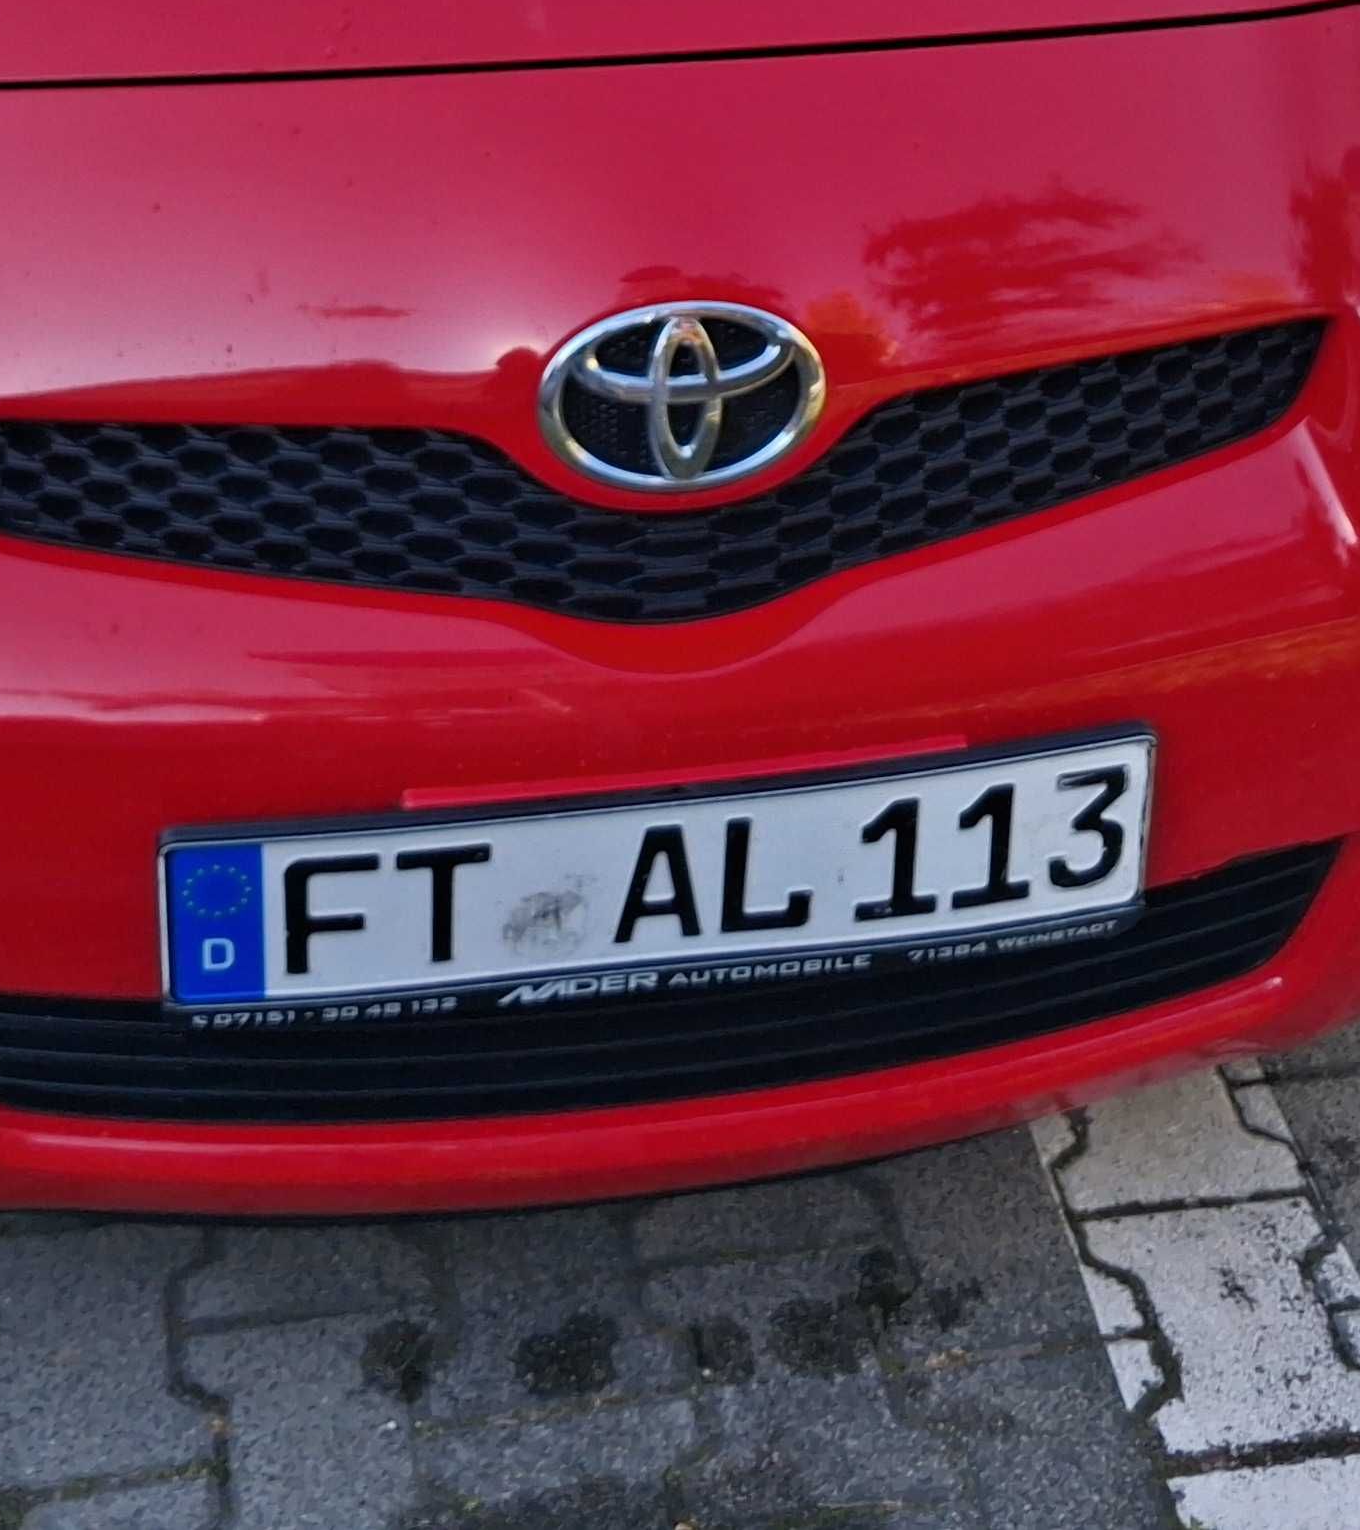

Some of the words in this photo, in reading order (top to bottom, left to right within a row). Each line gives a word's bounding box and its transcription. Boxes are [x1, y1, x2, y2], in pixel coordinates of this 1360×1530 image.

[283, 843, 492, 974] FT
[614, 816, 813, 943] AL
[853, 764, 1128, 922] 113
[996, 919, 1118, 951] WEINSTADT
[202, 937, 236, 971] D
[667, 953, 872, 988] AUTOMOBILE
